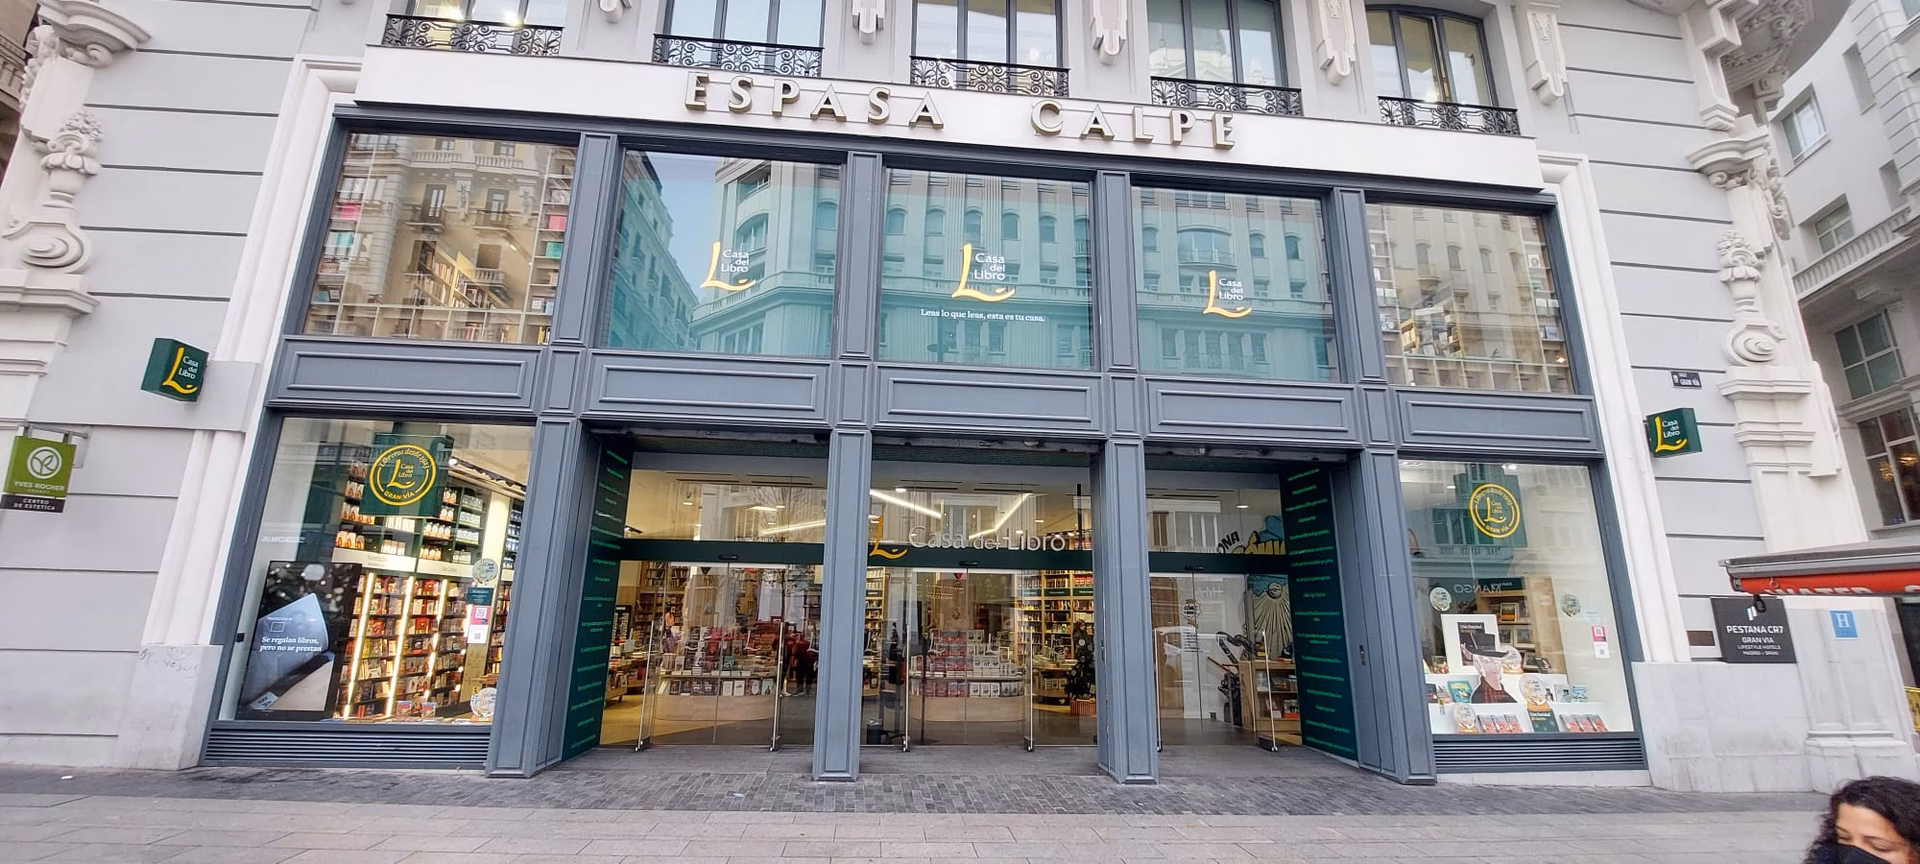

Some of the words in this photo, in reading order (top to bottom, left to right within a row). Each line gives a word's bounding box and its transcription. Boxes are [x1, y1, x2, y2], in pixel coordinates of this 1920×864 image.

[685, 71, 944, 129] ESPASA
[1031, 100, 1236, 150] CALPE
[723, 249, 750, 259] Casa
[975, 252, 1005, 264] Casa
[721, 263, 749, 273] Libro
[989, 264, 1006, 272] del
[974, 269, 1006, 281] Libro
[1219, 277, 1243, 287] Casa
[1219, 291, 1244, 301] Libro
[920, 308, 940, 317] Leas
[941, 309, 950, 317] lo
[951, 311, 967, 320] que
[967, 310, 986, 320] leas,
[182, 356, 199, 368] Casa
[178, 368, 196, 380] Libro
[1661, 420, 1678, 428] Casa
[1663, 430, 1681, 439] Libro
[34, 483, 65, 491] ROCHER
[383, 490, 402, 500] GRAN
[908, 525, 967, 549] Casa
[973, 534, 1000, 550] del
[1006, 527, 1067, 552] Libro
[1726, 625, 1767, 634] PESTANA
[1767, 625, 1784, 634] CR7
[273, 636, 297, 645] regalan
[260, 645, 276, 653] pero
[295, 645, 322, 653] prestan
